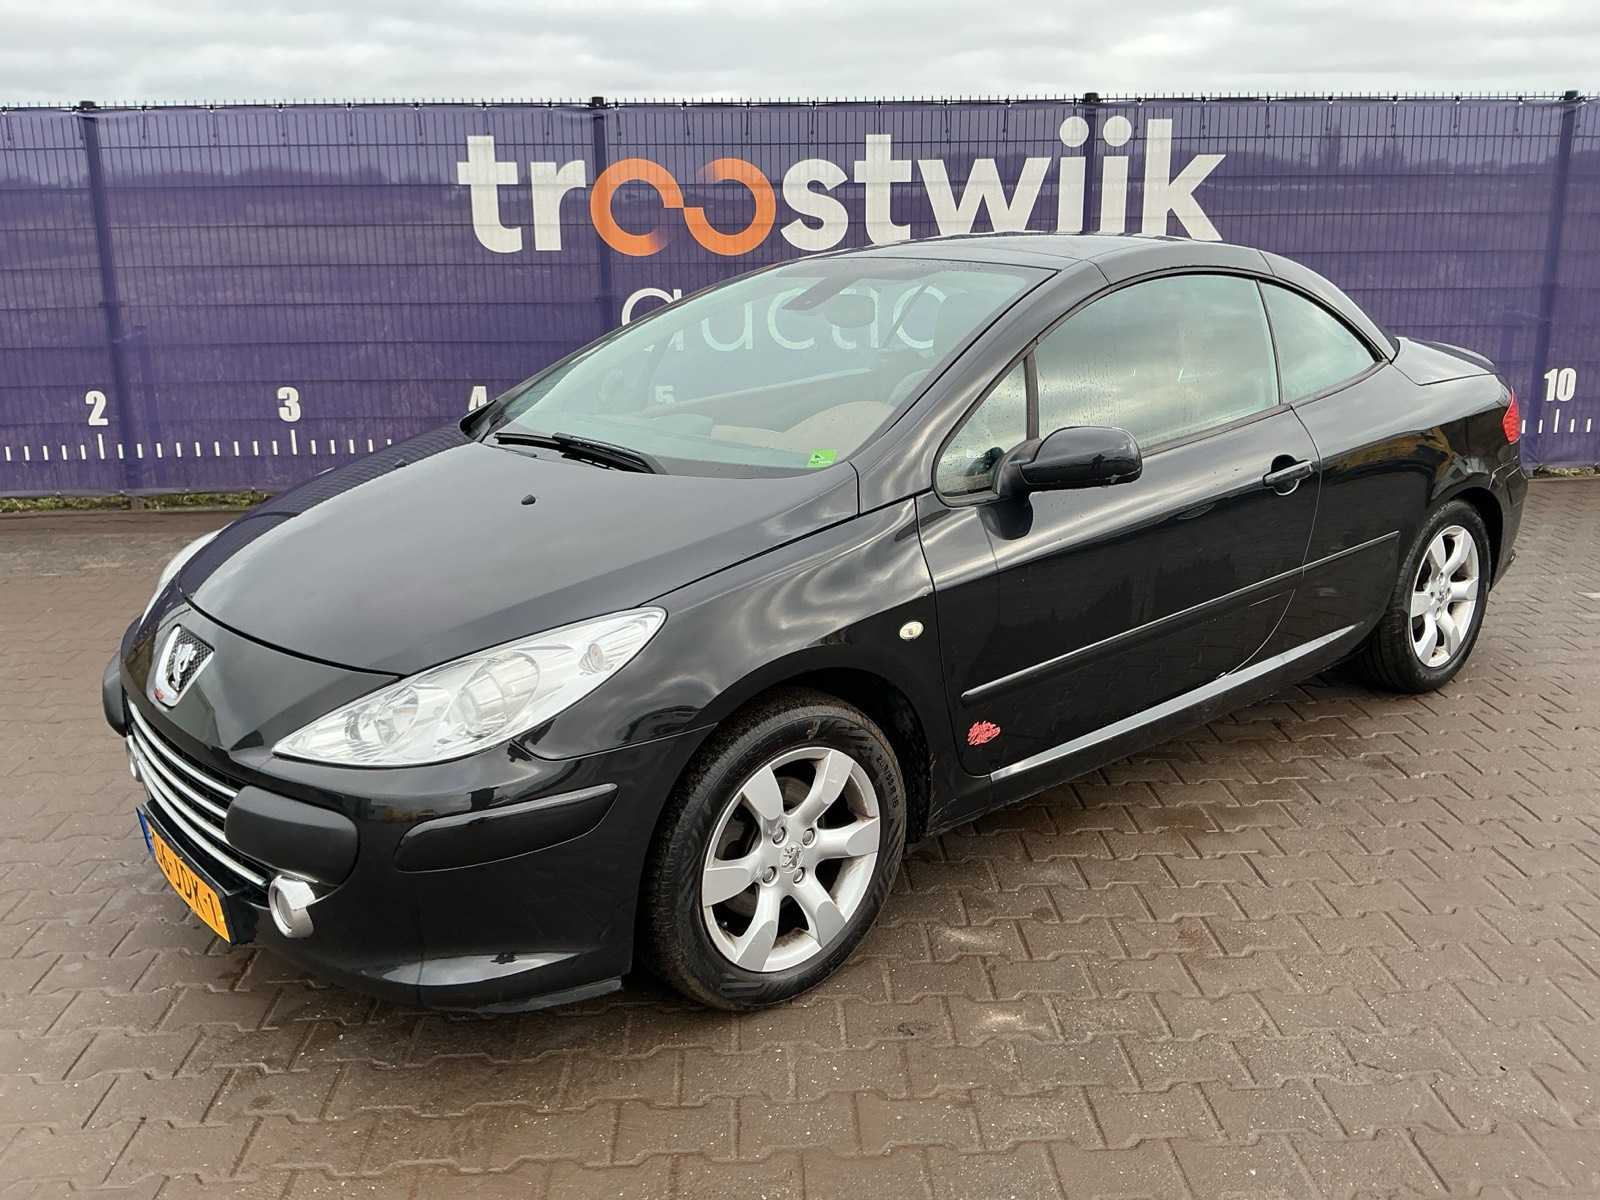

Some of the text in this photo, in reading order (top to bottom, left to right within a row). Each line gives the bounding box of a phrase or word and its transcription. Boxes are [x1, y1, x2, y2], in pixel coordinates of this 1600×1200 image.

[85, 390, 109, 426] 2
[277, 386, 301, 422] 3
[1543, 367, 1577, 402] 10
